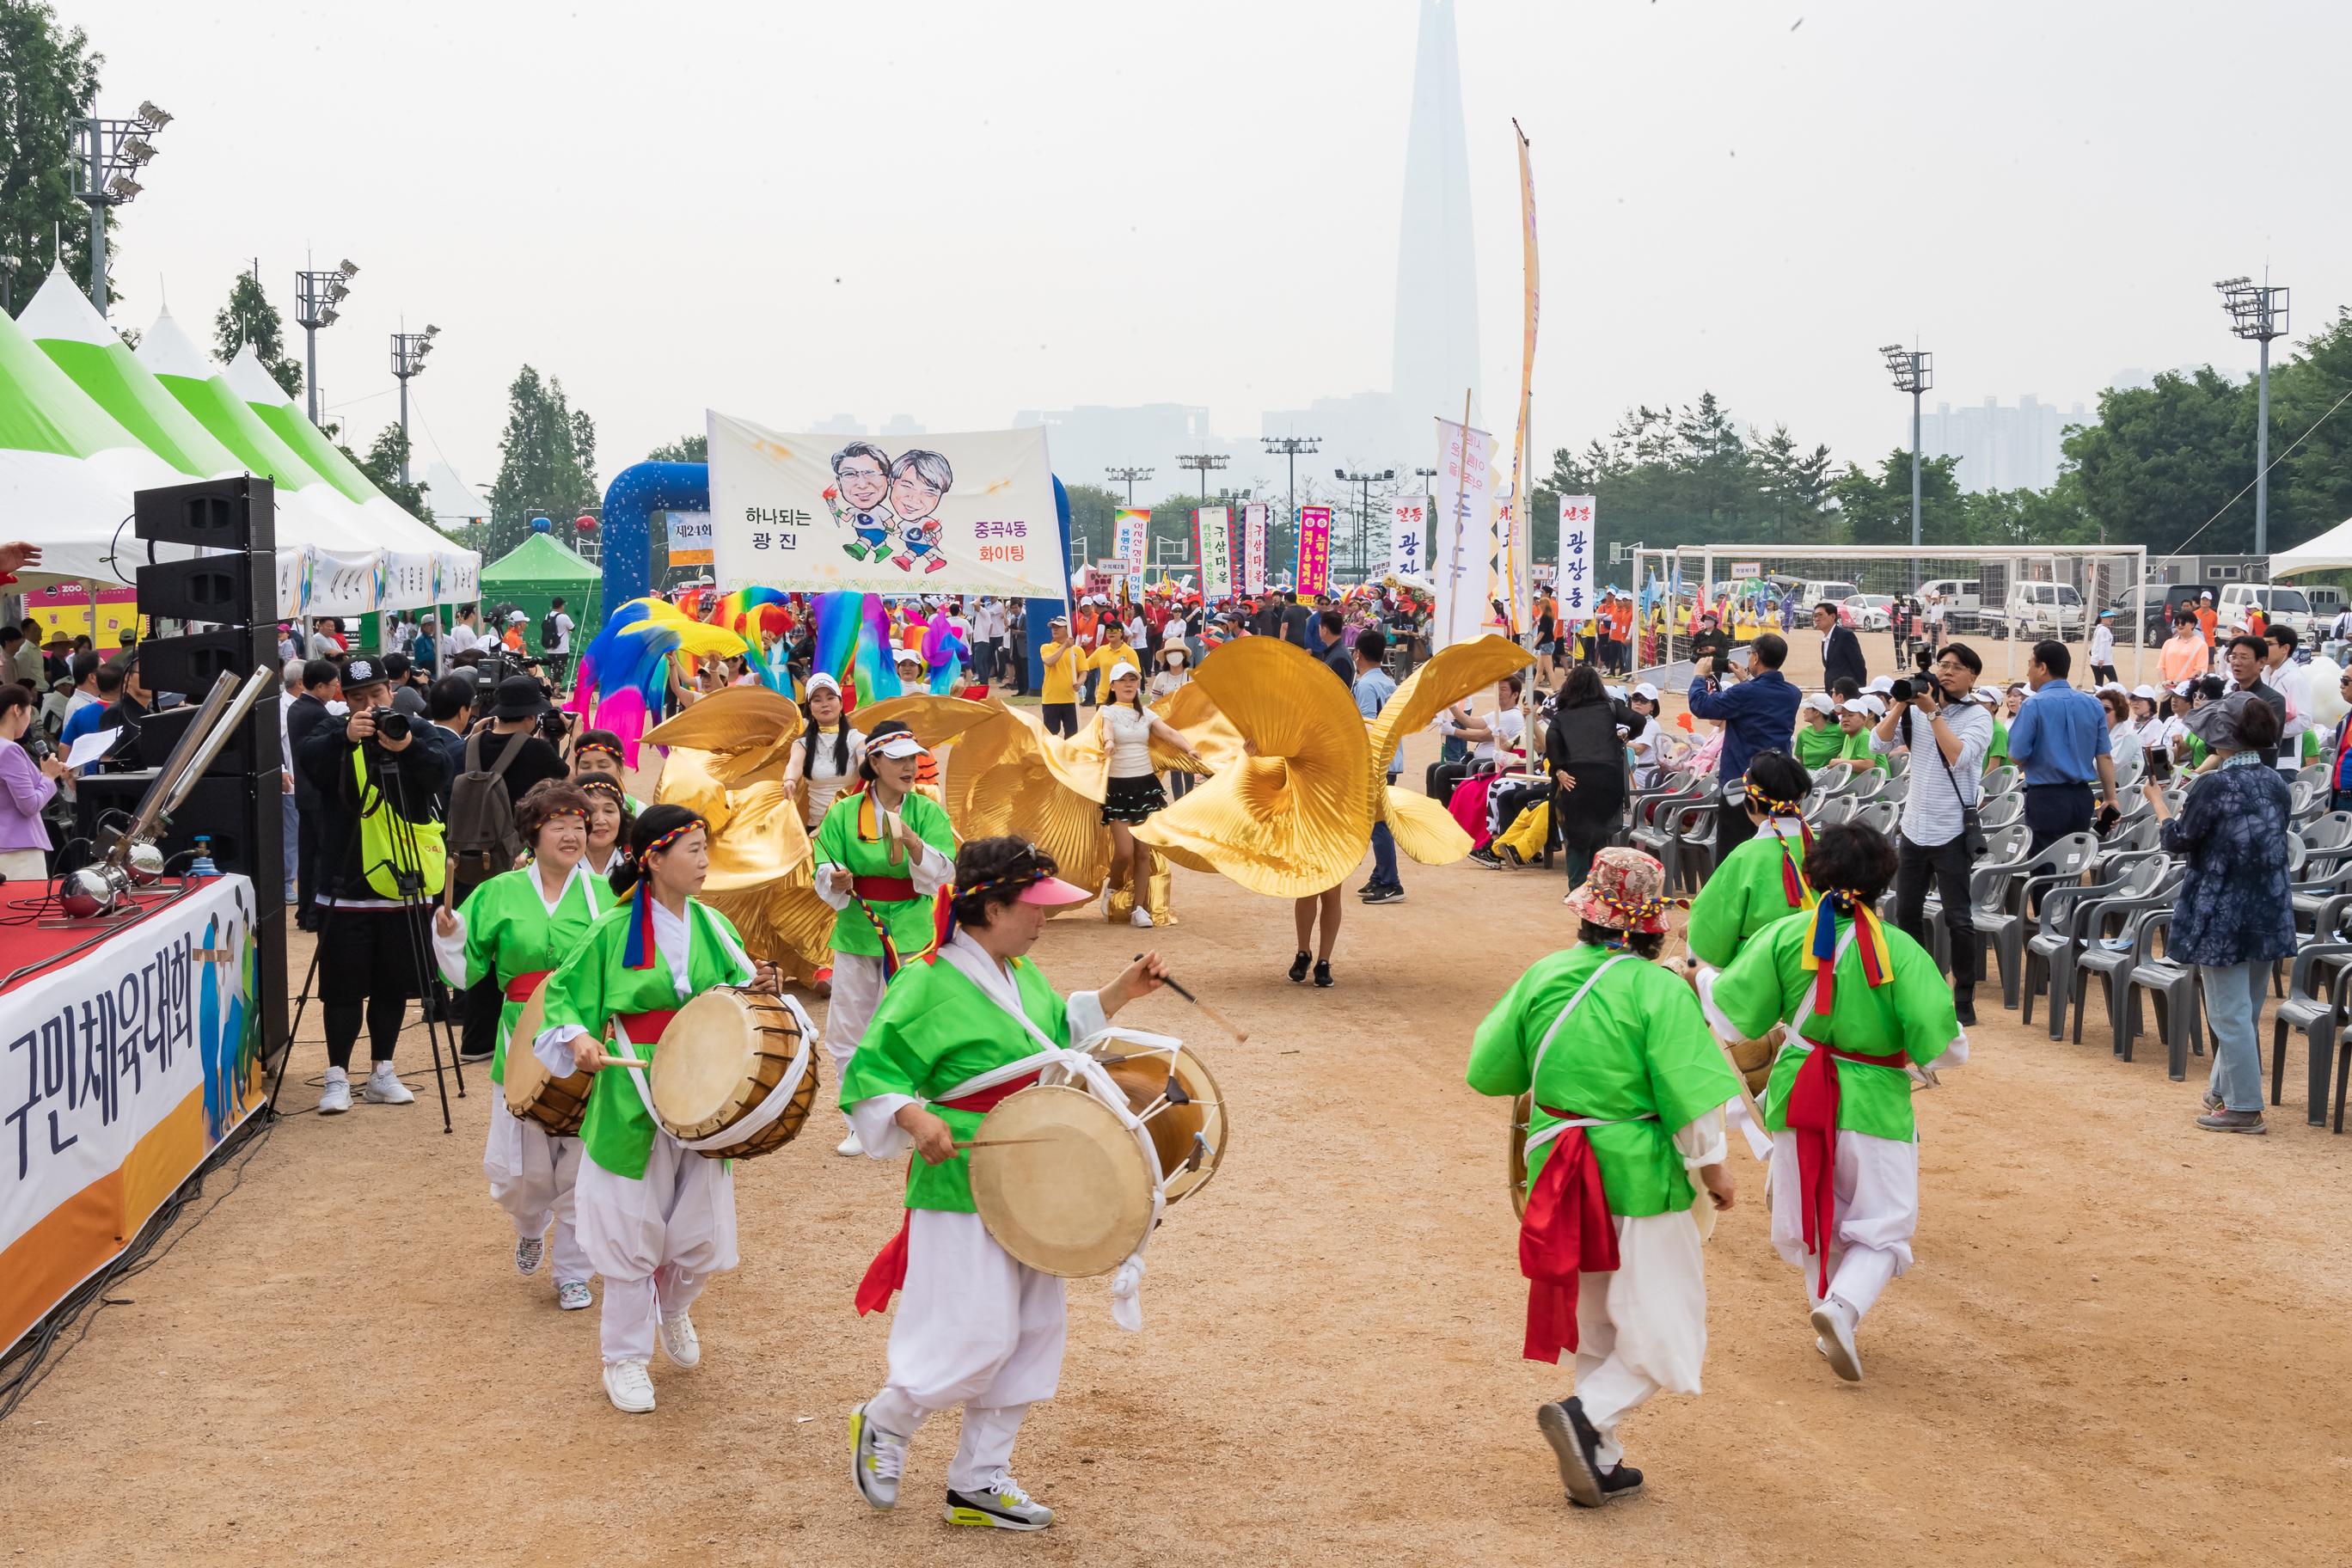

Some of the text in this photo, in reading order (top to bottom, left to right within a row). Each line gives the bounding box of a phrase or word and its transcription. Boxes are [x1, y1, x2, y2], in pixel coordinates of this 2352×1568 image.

[745, 507, 812, 526] 하나되는
[1396, 506, 1423, 522] 일등
[1563, 506, 1590, 521] 선봉
[675, 524, 712, 538] 제24회
[974, 521, 1027, 539] 중곡4동
[979, 545, 1024, 562] 화이팅
[1214, 526, 1228, 584] 구삼마을
[1253, 524, 1262, 583] 구삼마을
[1565, 530, 1588, 608] 광장동
[61, 585, 83, 593] ZOO
[1130, 576, 1140, 604] 이어받
